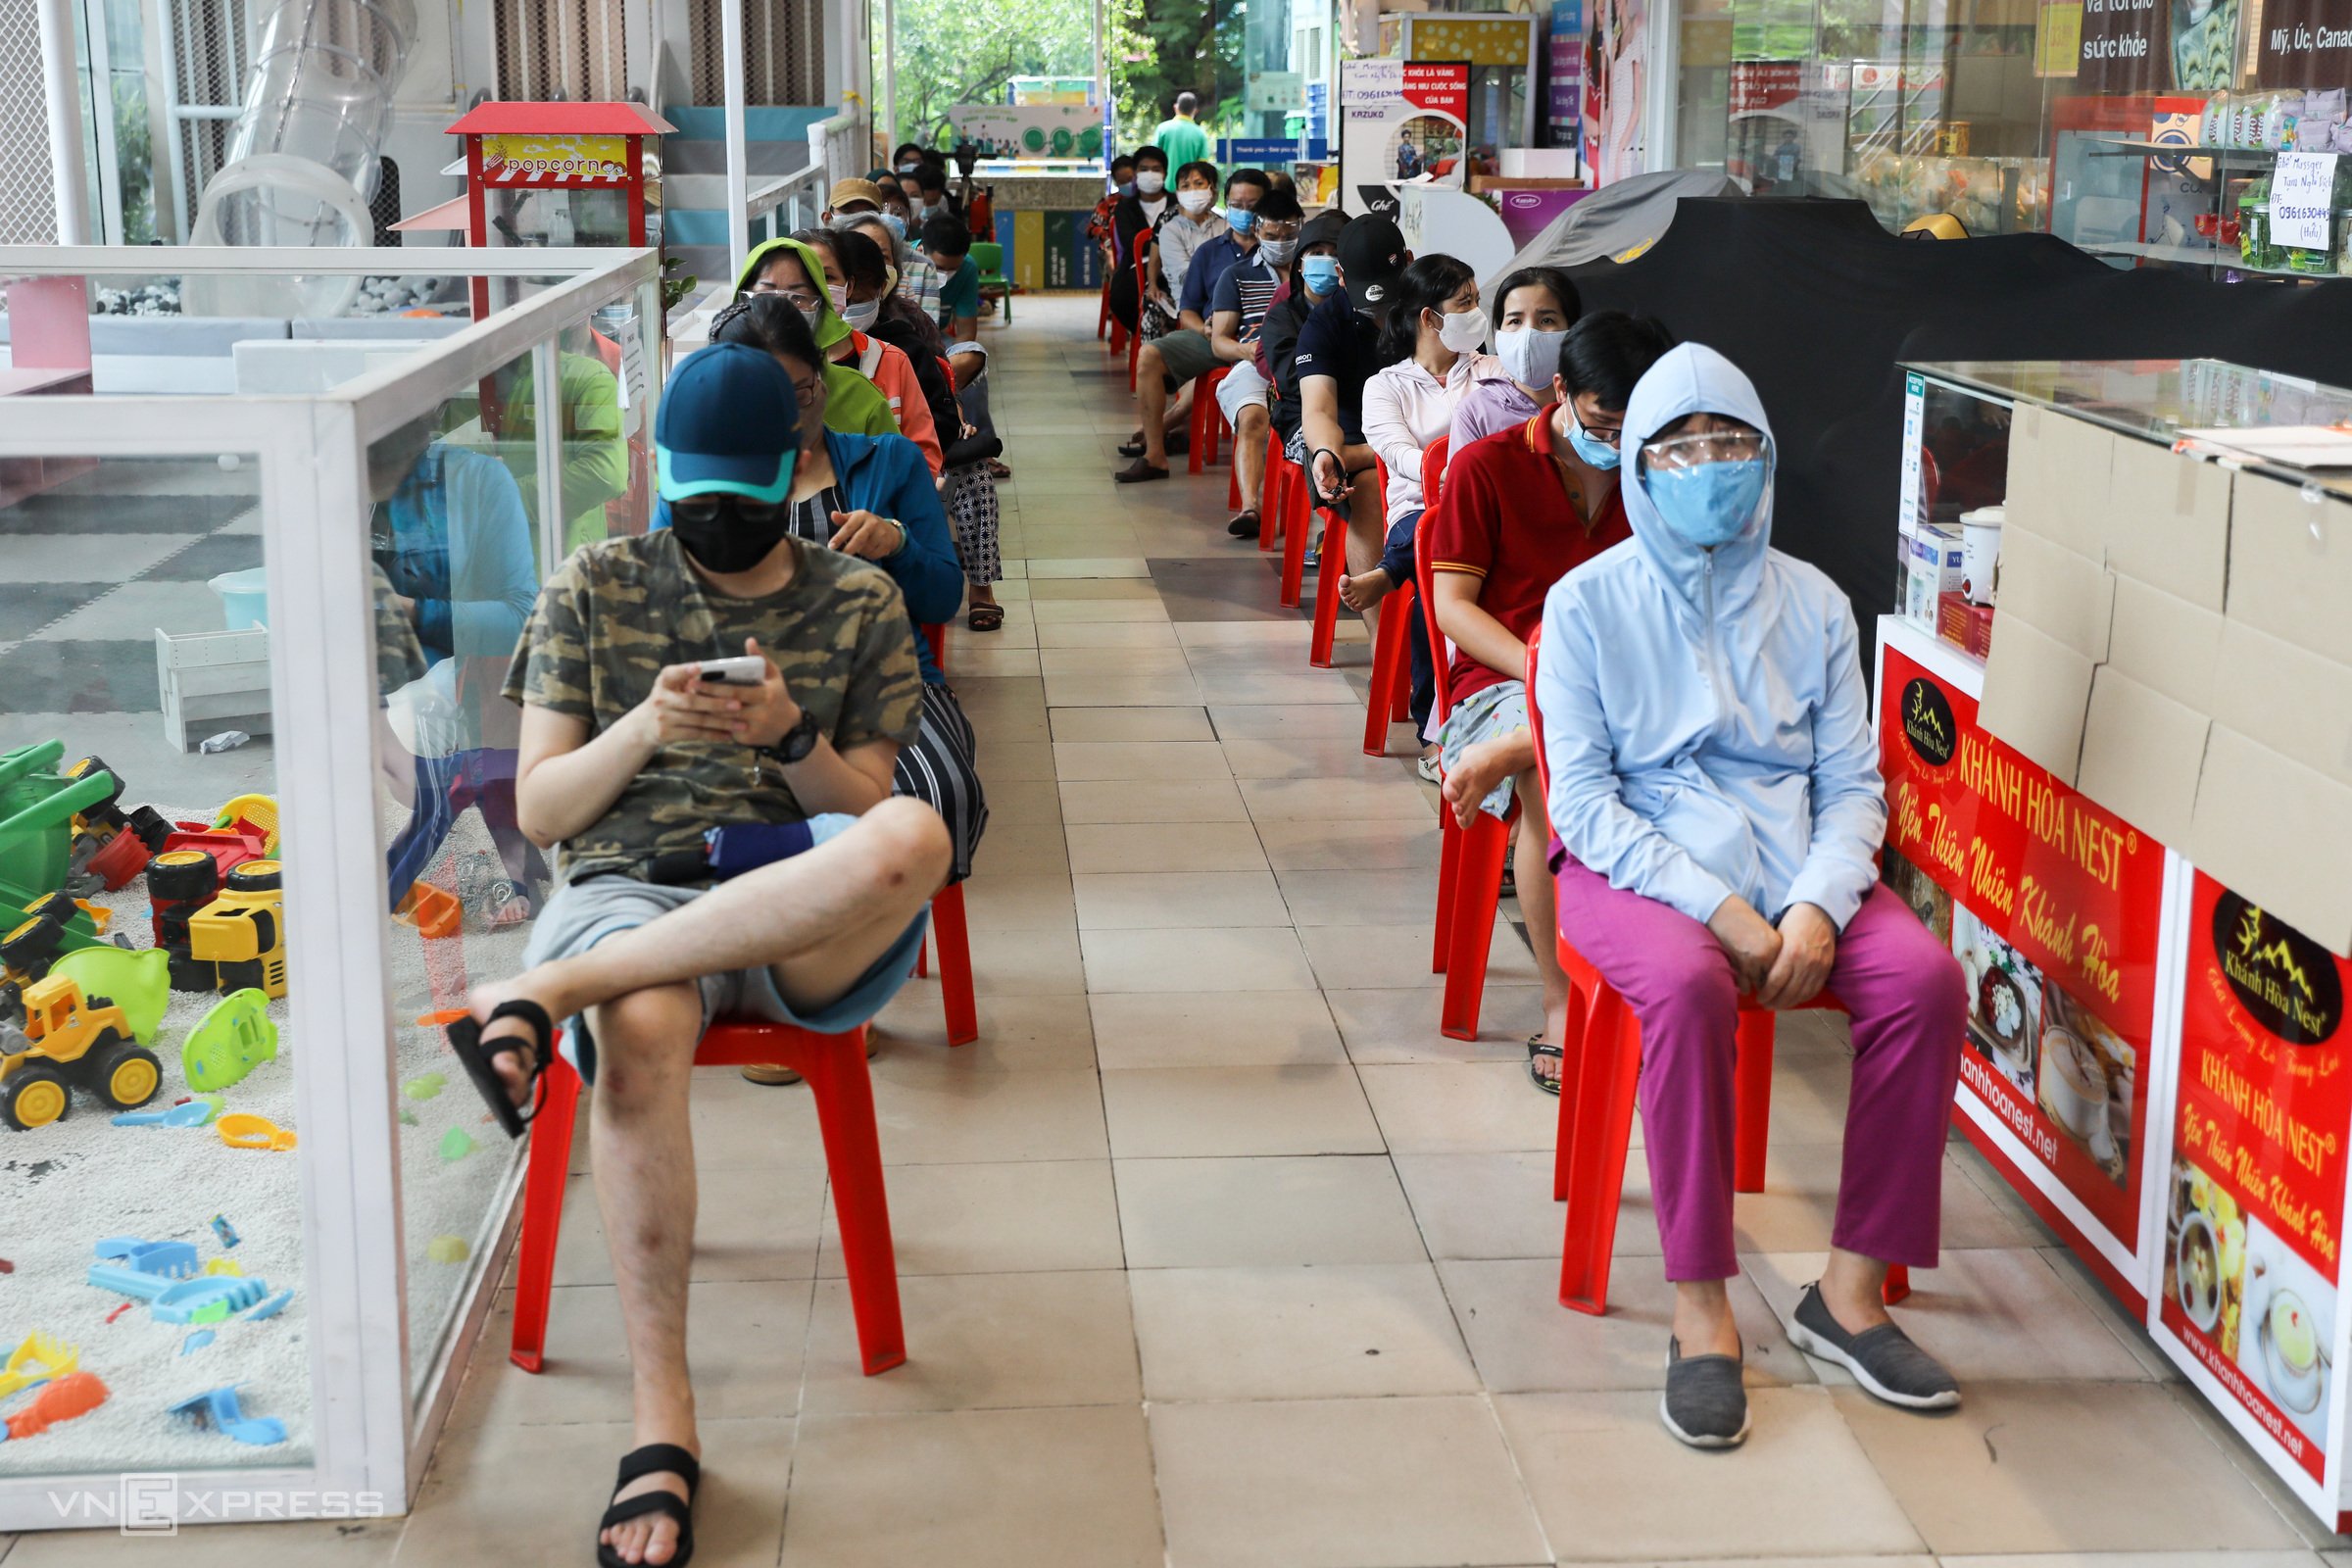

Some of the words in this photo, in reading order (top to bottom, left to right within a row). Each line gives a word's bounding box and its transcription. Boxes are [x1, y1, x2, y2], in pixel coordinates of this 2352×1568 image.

[2083, 34, 2117, 60] sức
[2119, 30, 2147, 58] khỏe
[2271, 28, 2290, 56] Mỹ,
[2294, 22, 2313, 53] Úc,
[508, 158, 601, 173] popcorn
[1371, 200, 1395, 212] Ghế
[1960, 733, 2022, 822] KHÁNH
[2027, 772, 2065, 855] HÒA
[1898, 781, 1923, 847] Yến
[1928, 803, 1965, 877] Thiên
[1971, 836, 2014, 917] Nhiên
[2020, 875, 2077, 965] Khánh
[2082, 924, 2120, 1004] Hòa
[2225, 950, 2262, 996] Khánh
[2265, 977, 2289, 1015] Hòa
[2201, 1050, 2250, 1119] KHÁNH
[2253, 1086, 2283, 1147] HÒA
[2206, 1119, 2233, 1174] Thiên
[2235, 1146, 2267, 1202] Nhiên
[2270, 1175, 2308, 1237] Khánh
[2183, 1325, 2303, 1459] www.khanhhoanest.net
